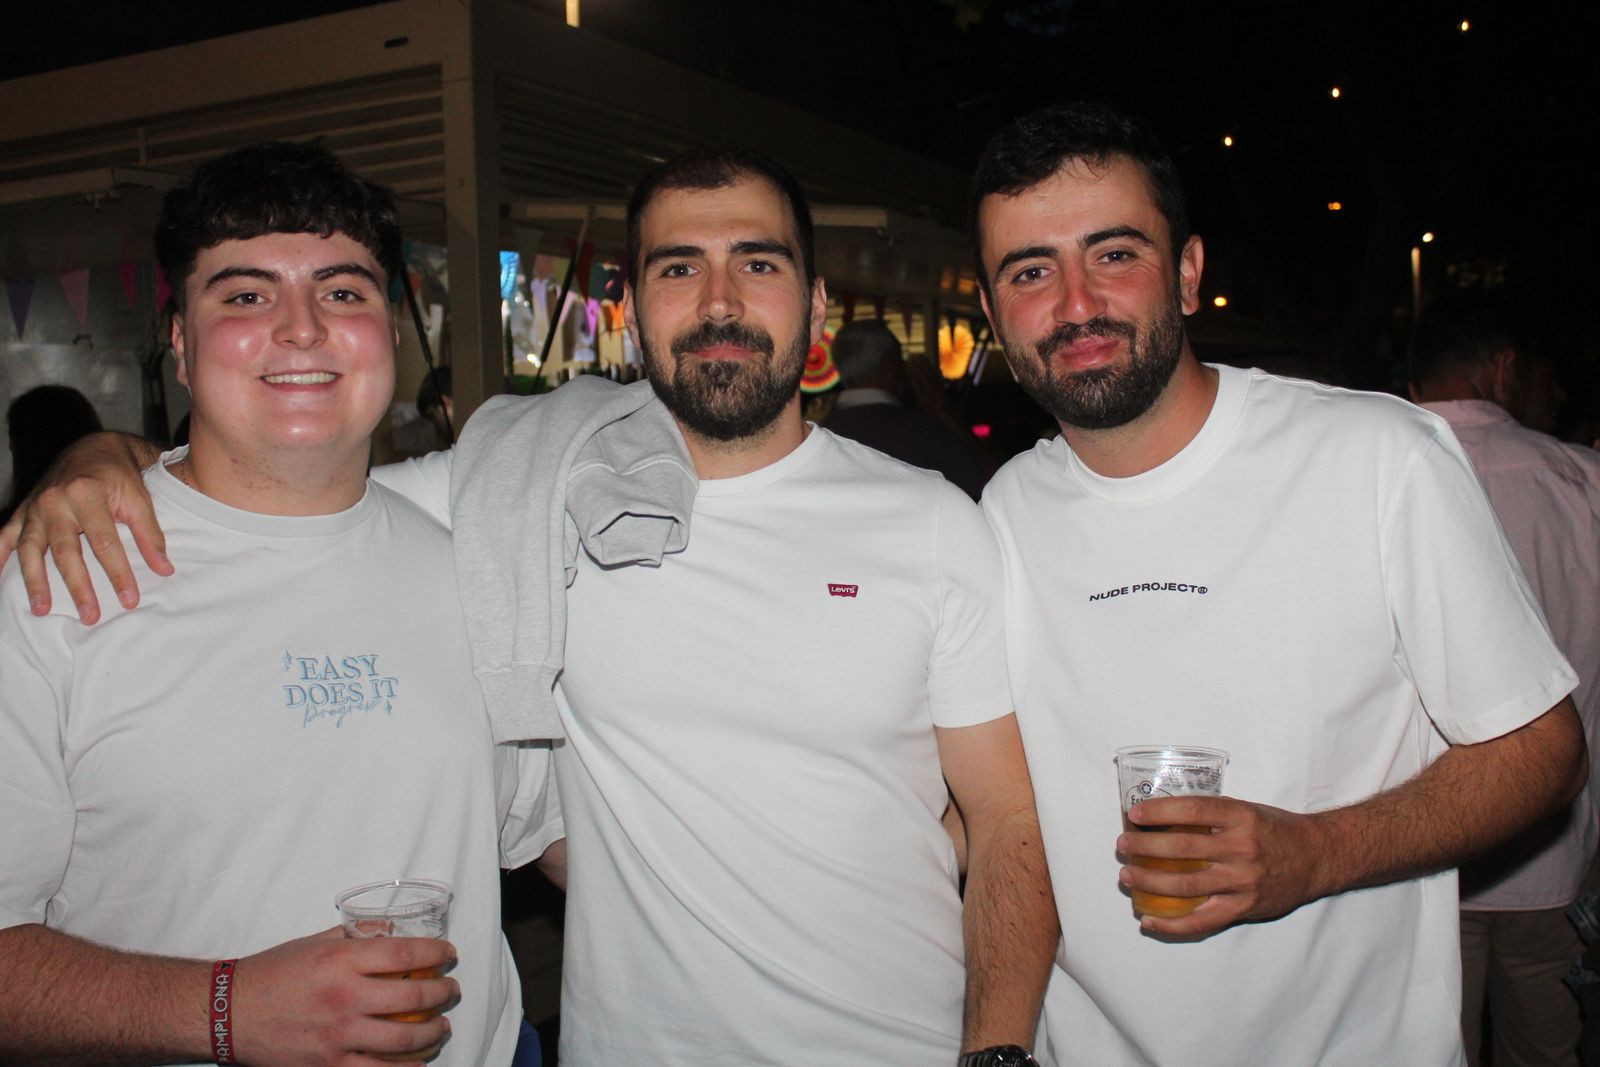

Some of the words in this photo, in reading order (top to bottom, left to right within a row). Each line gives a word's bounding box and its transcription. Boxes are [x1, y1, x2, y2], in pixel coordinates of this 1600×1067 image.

[1089, 586, 1129, 601] NUDE
[295, 654, 379, 680] EASY
[283, 682, 364, 708] DOES
[369, 677, 399, 699] IT
